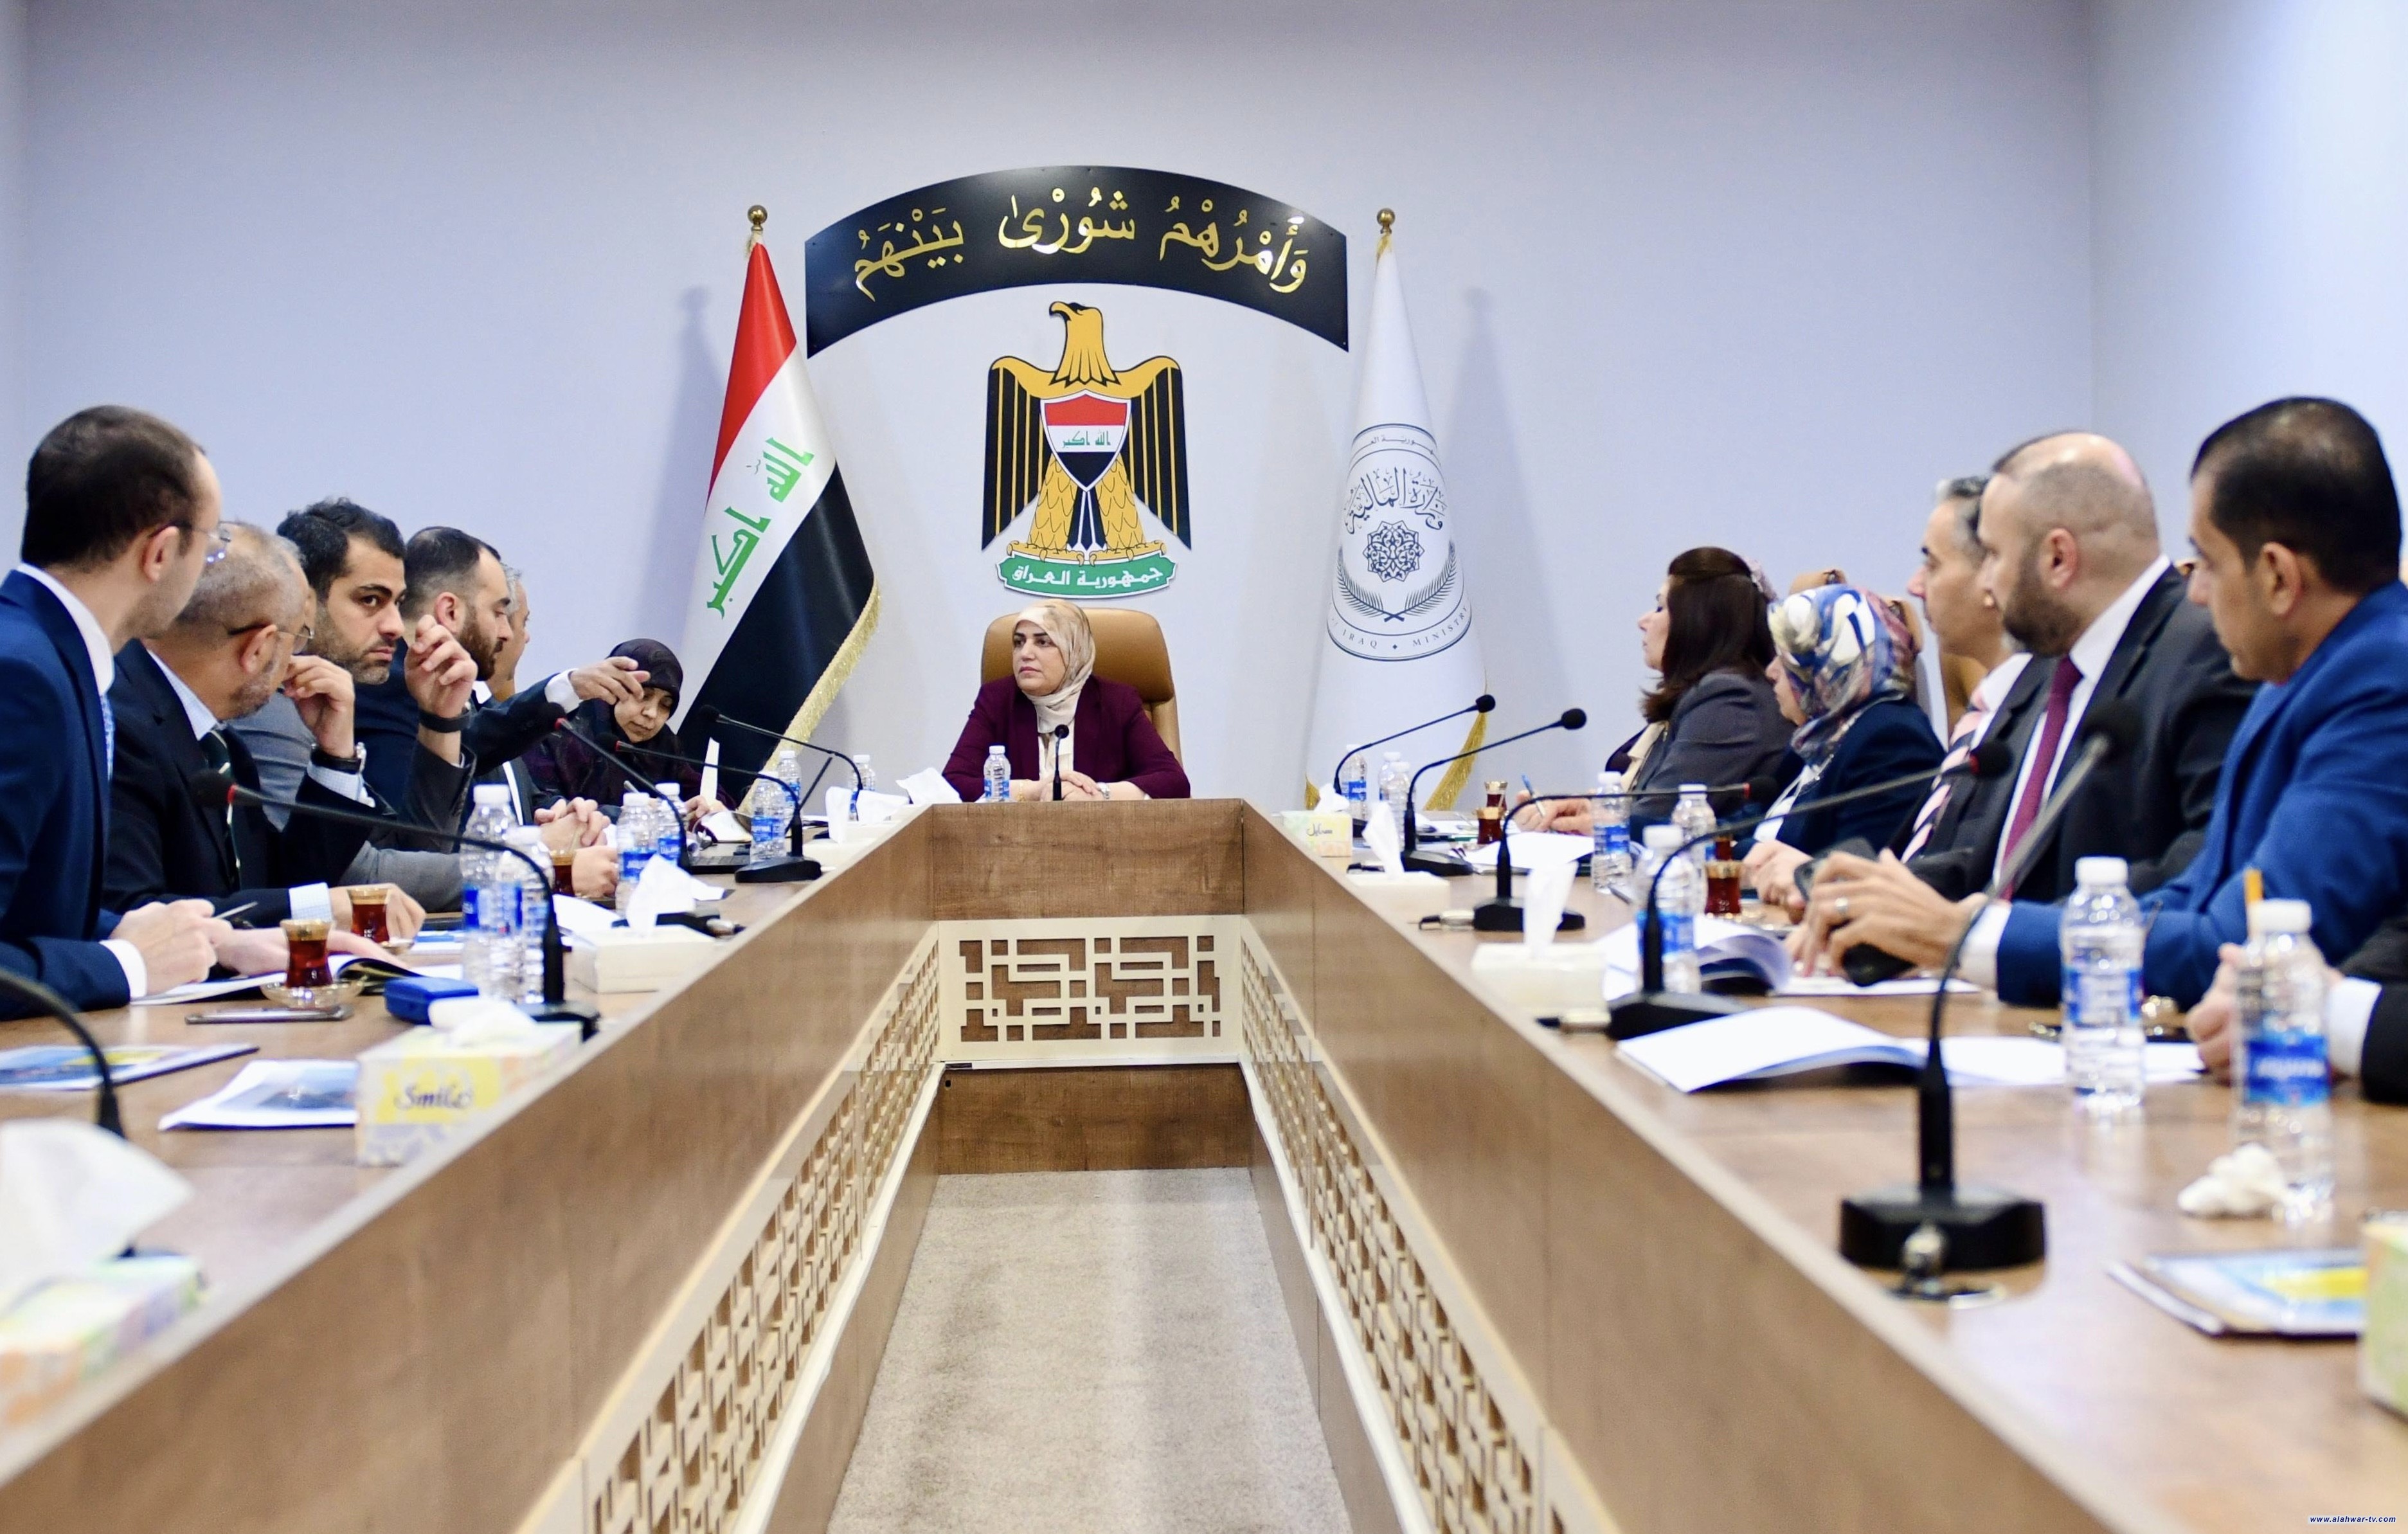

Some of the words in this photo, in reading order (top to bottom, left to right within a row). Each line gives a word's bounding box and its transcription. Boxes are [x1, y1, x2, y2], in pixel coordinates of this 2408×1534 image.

[1095, 429, 1111, 446] الله
[1012, 564, 1070, 586] العراق
[1077, 567, 1164, 589] جمهورية
[1342, 629, 1378, 649] IRAQ
